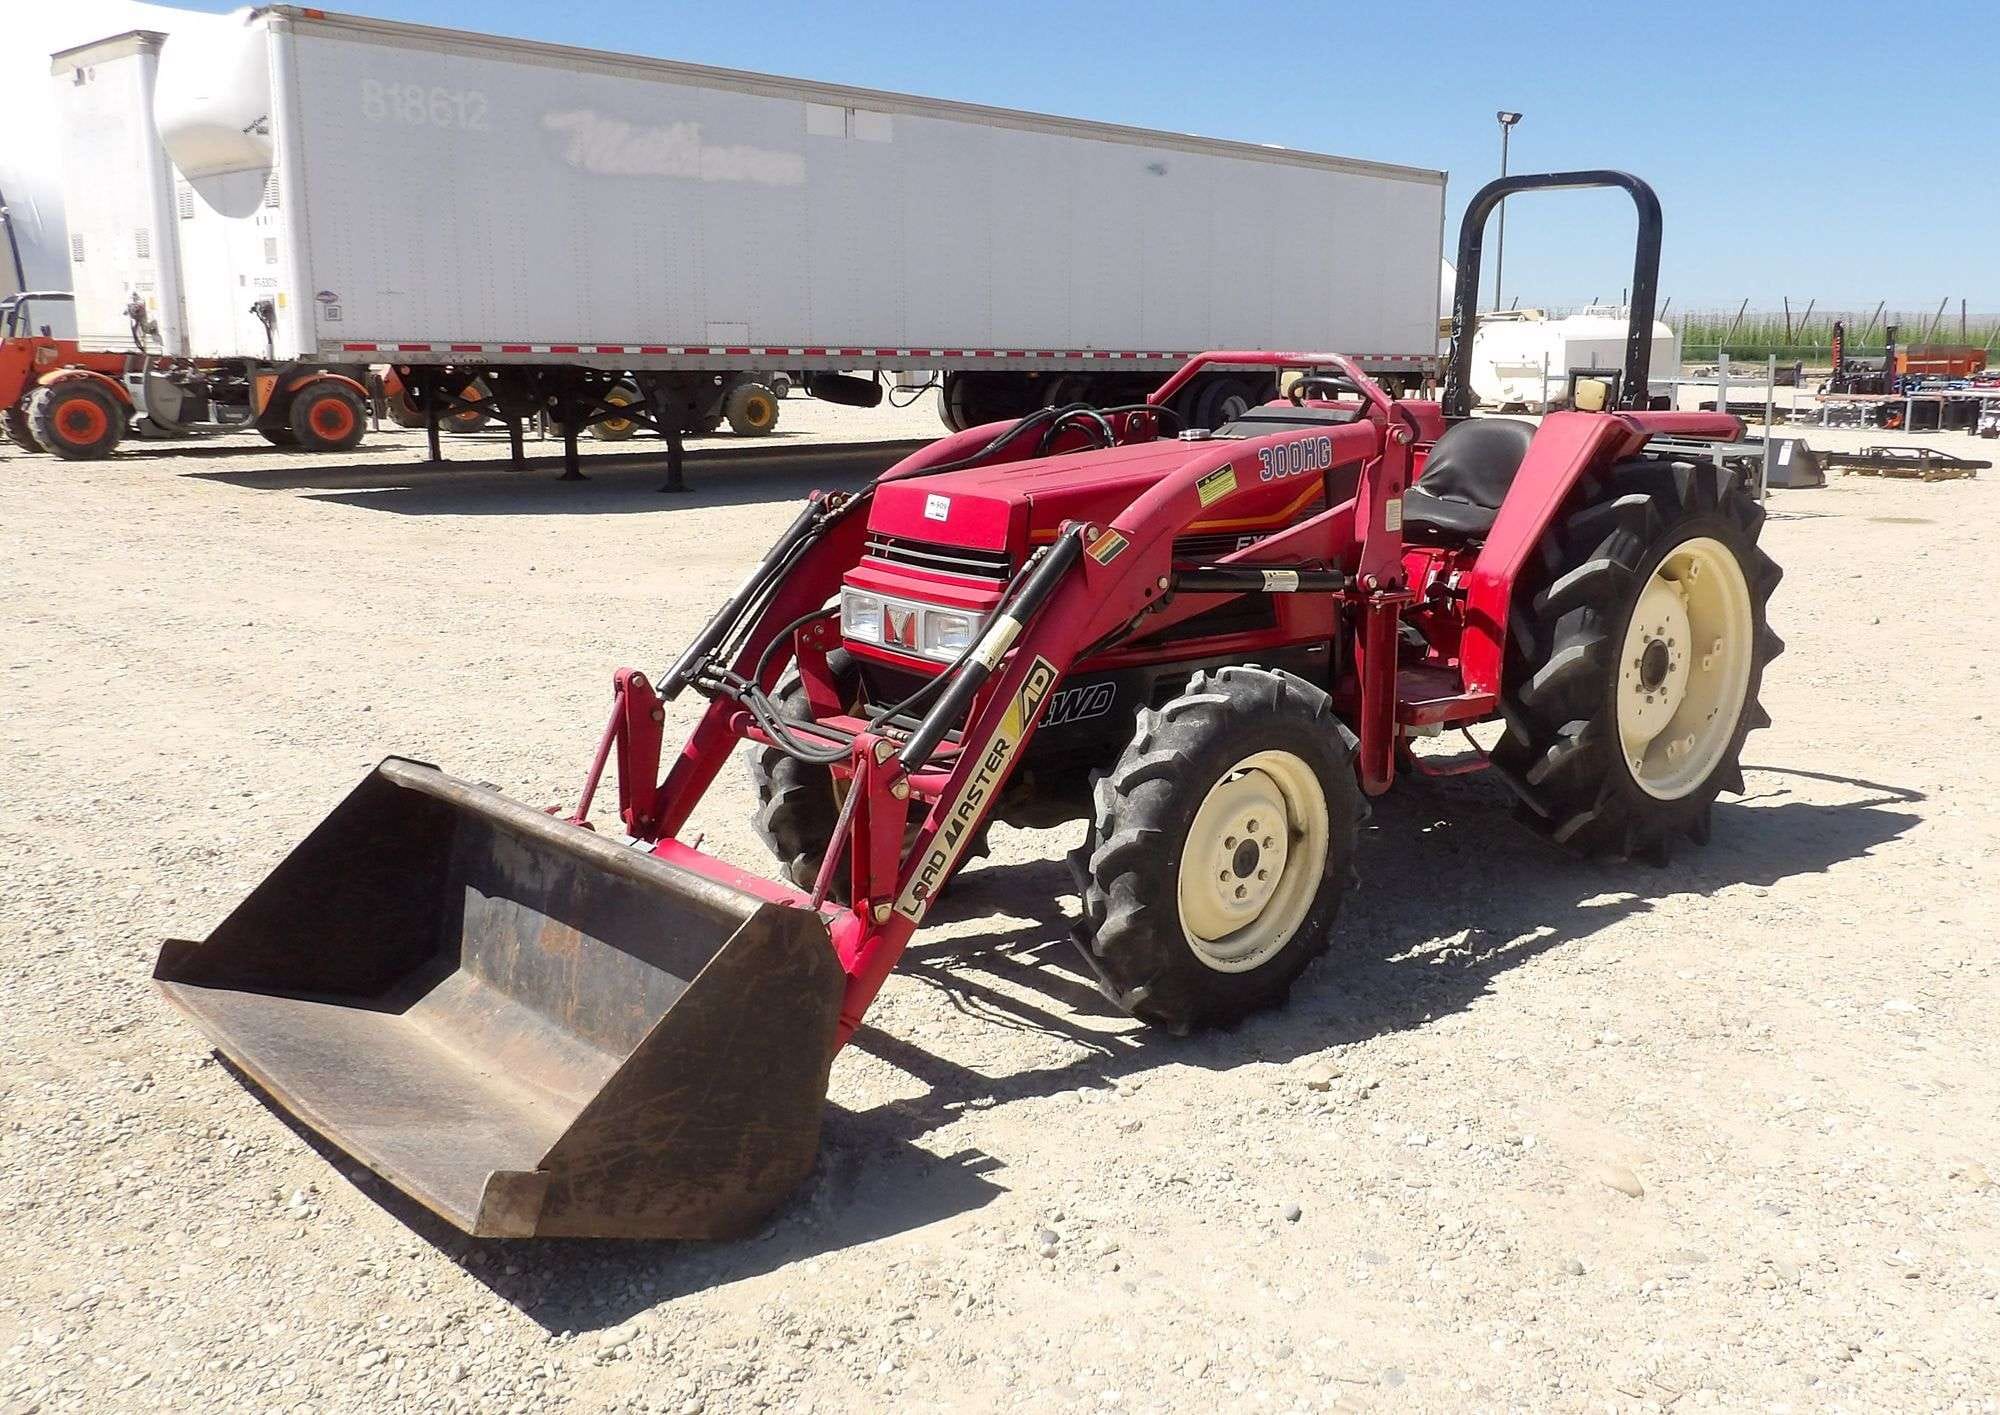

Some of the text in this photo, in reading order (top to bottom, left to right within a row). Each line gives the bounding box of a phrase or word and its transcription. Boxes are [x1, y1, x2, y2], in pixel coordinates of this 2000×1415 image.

[1258, 436, 1332, 482] 300HG
[902, 738, 1011, 916] LOAD MASTER
